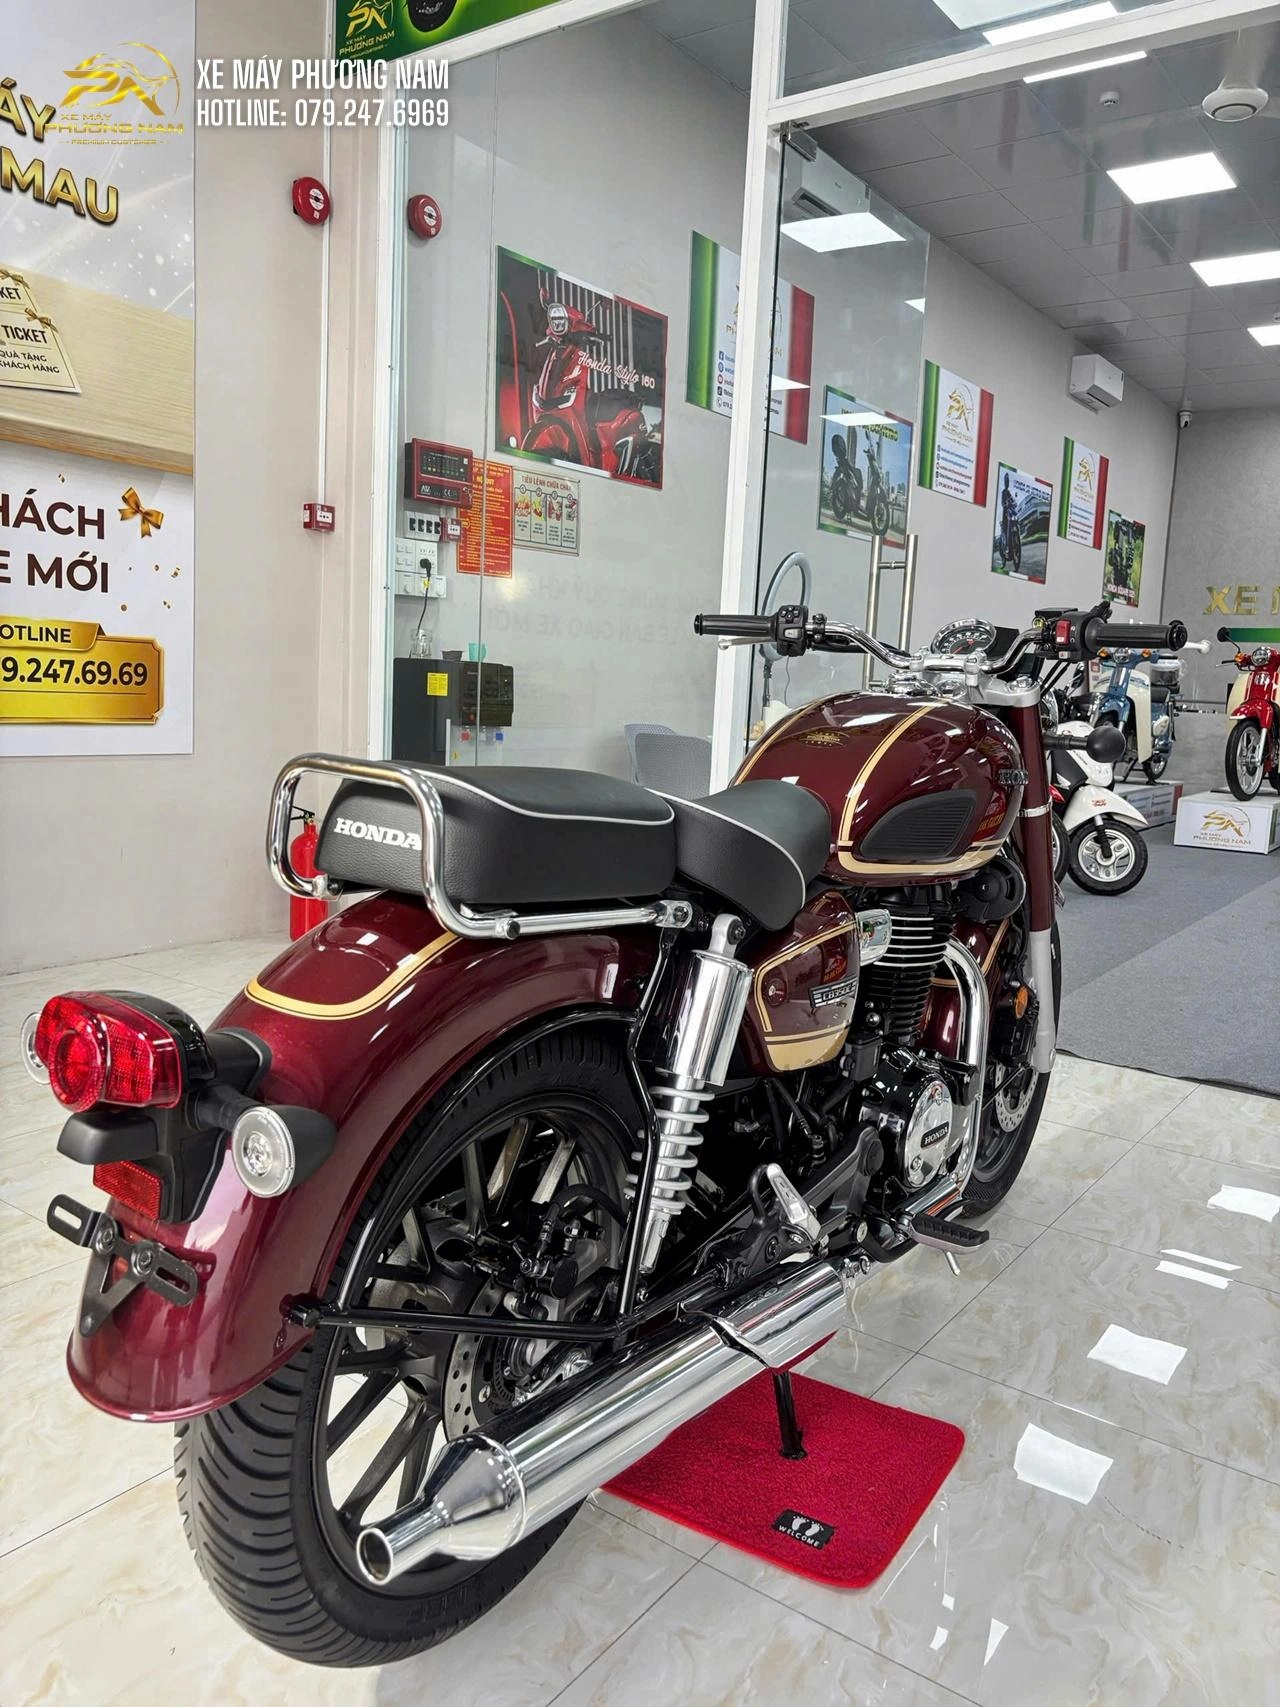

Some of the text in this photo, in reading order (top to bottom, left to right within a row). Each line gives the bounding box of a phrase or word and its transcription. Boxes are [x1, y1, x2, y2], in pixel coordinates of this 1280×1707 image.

[375, 30, 395, 43] NAM
[0, 145, 119, 226] MAU
[1, 325, 47, 344] TICKET
[32, 363, 60, 373] HÀNG
[578, 350, 656, 389] Honda Stylo 160
[27, 551, 109, 593] MỚI
[1202, 586, 1258, 616] XE
[1, 656, 148, 686] 9.247.69.69
[333, 817, 422, 850] HONDA
[924, 1126, 948, 1145] HONDA
[779, 1525, 820, 1547] WELCOME
